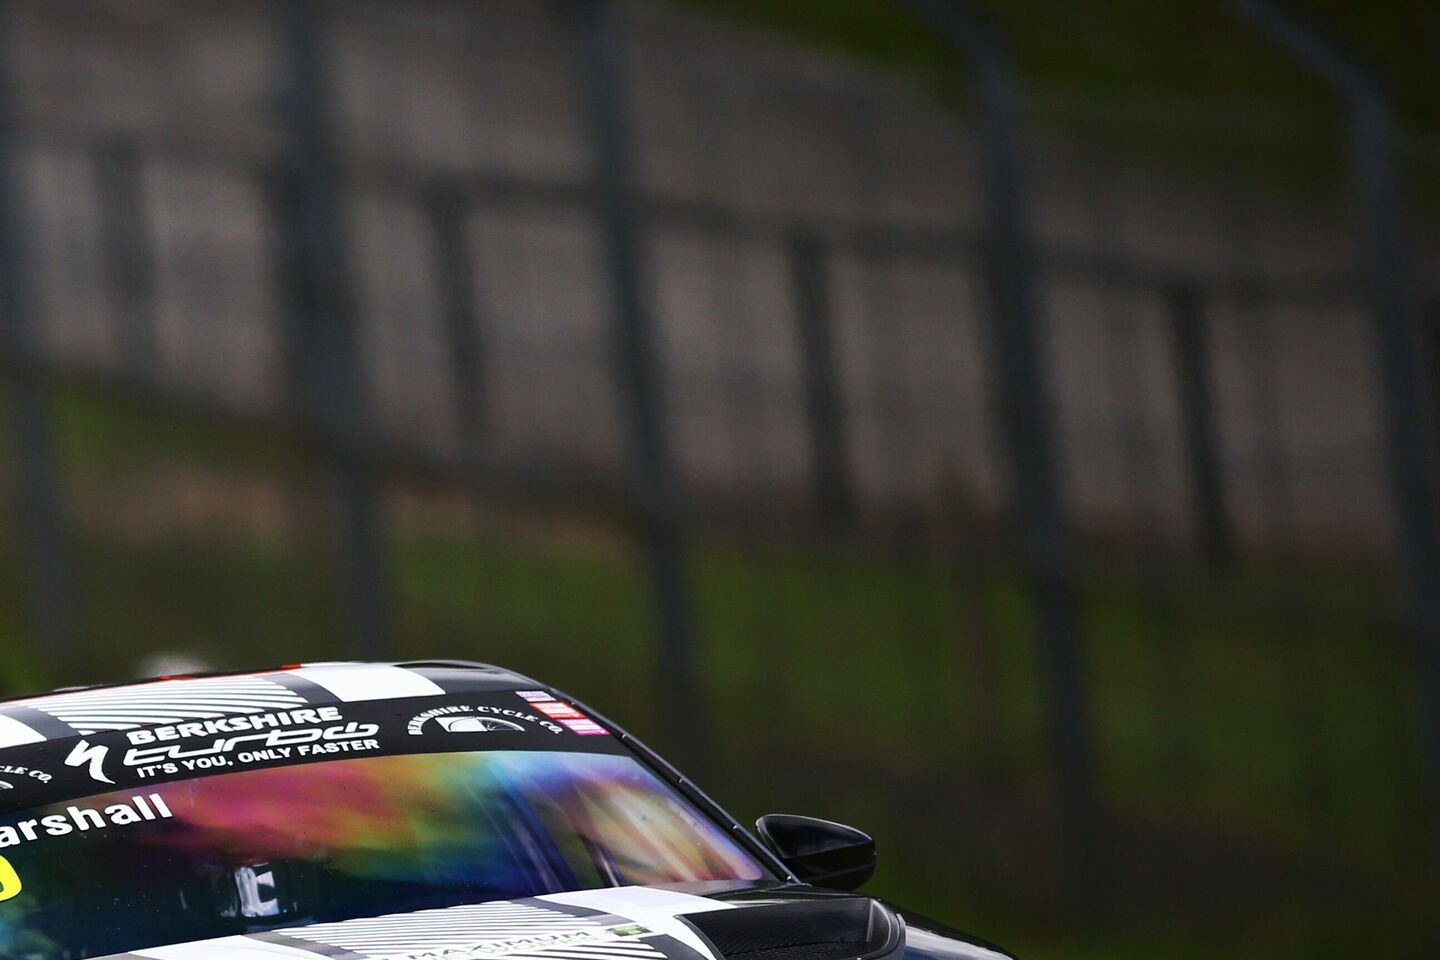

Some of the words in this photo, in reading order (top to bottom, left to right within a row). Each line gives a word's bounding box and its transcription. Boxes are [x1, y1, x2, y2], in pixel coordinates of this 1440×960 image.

[126, 706, 343, 746] BERKSHIRE
[477, 705, 539, 723] CYCLE
[136, 761, 179, 778] IT'S
[181, 754, 233, 772] YOU,
[237, 747, 292, 763] ONLY
[296, 738, 380, 757] FASTER
[28, 769, 53, 784] CO.
